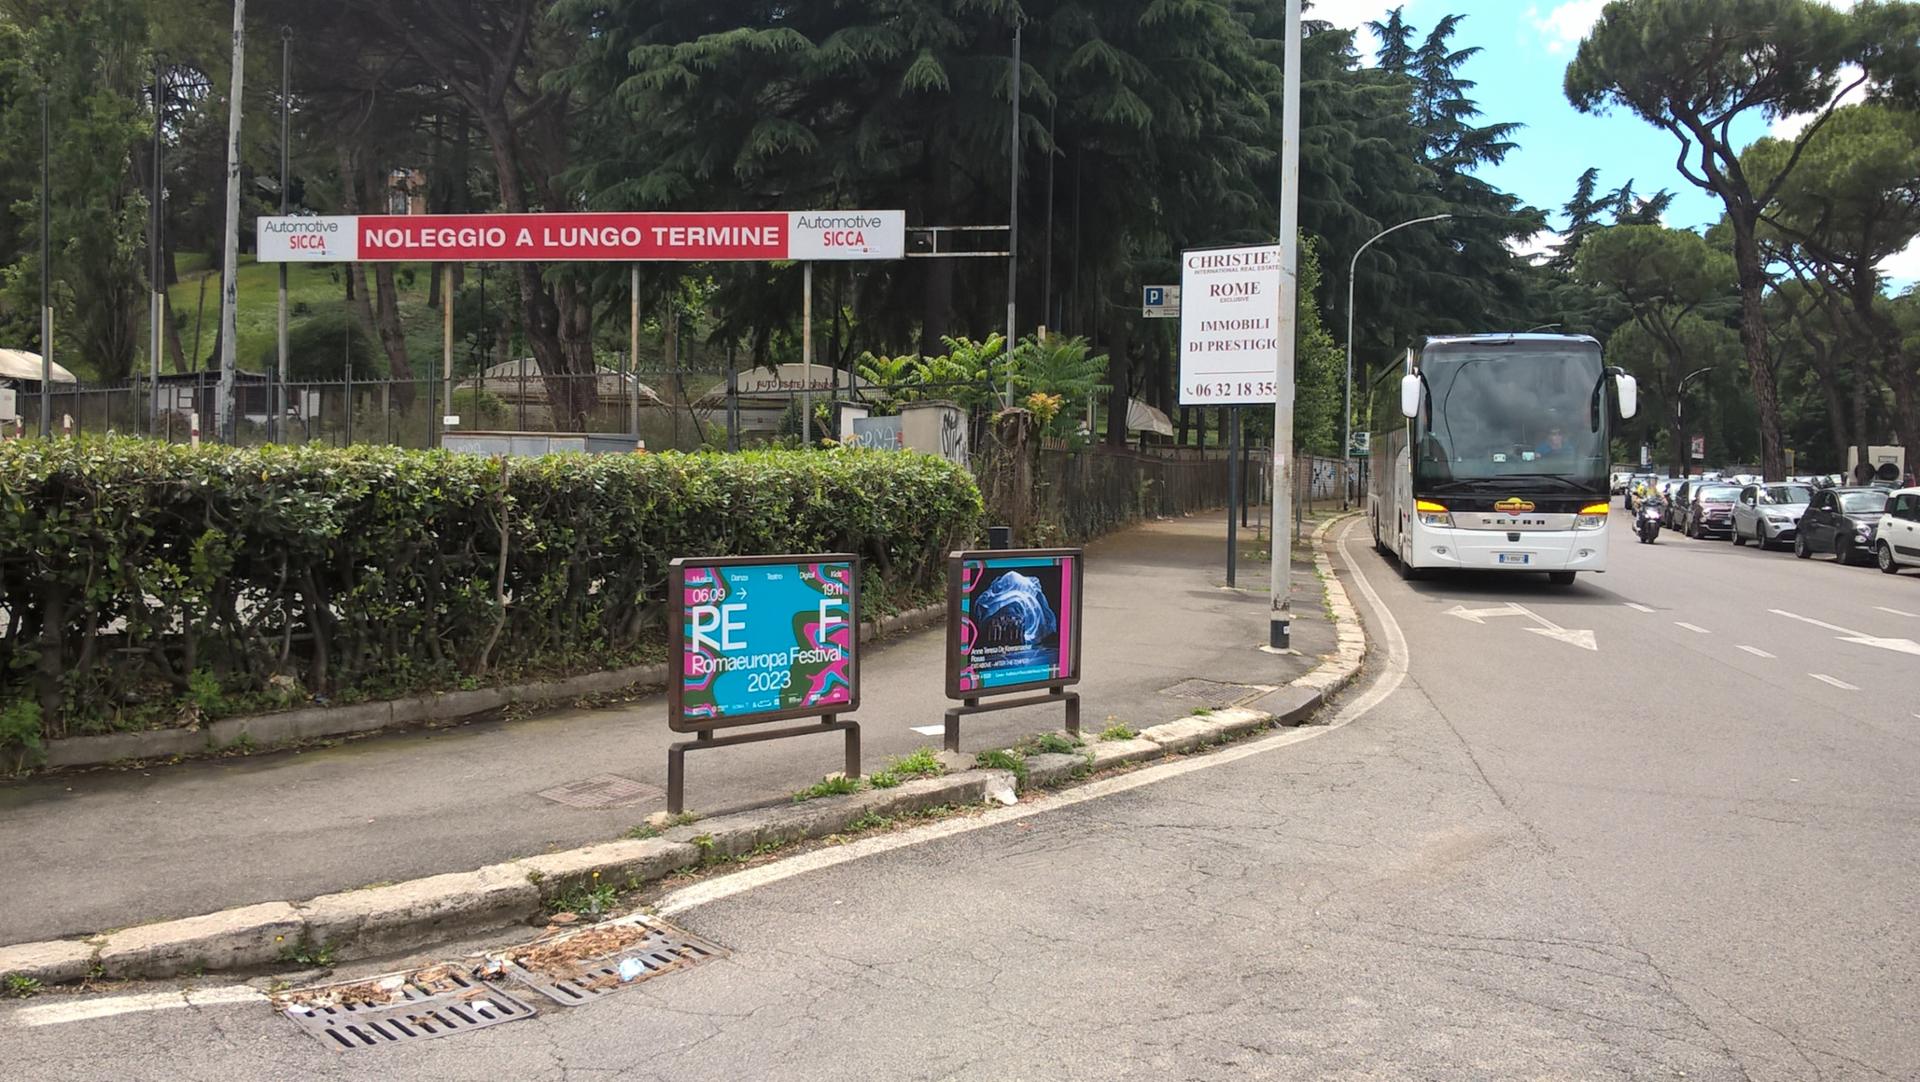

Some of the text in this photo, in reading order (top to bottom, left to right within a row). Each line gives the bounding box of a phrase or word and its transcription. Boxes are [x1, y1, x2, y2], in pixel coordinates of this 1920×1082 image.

[264, 219, 338, 233] Automotive
[797, 215, 881, 229] Automotive
[289, 234, 325, 249] SICCA
[365, 226, 779, 248] NOLEGGIO A LUNGO TERMINE
[823, 231, 865, 246] SICCA
[1194, 267, 1239, 275] INTERNATIONAL
[1150, 290, 1159, 303] P
[1210, 282, 1261, 297] ROME
[1200, 318, 1270, 332] IMMOBILI
[1189, 341, 1203, 352] DI
[1196, 383, 1211, 397] 06
[1215, 383, 1231, 397] 32
[1237, 382, 1252, 396] 18
[730, 574, 749, 582] Danza
[766, 573, 783, 581] Teatro
[830, 570, 842, 578] Kids
[692, 588, 726, 603] 06.09
[692, 599, 842, 653] RE F
[692, 644, 842, 674] Romaeuropa Festival
[747, 671, 792, 692] 2023
